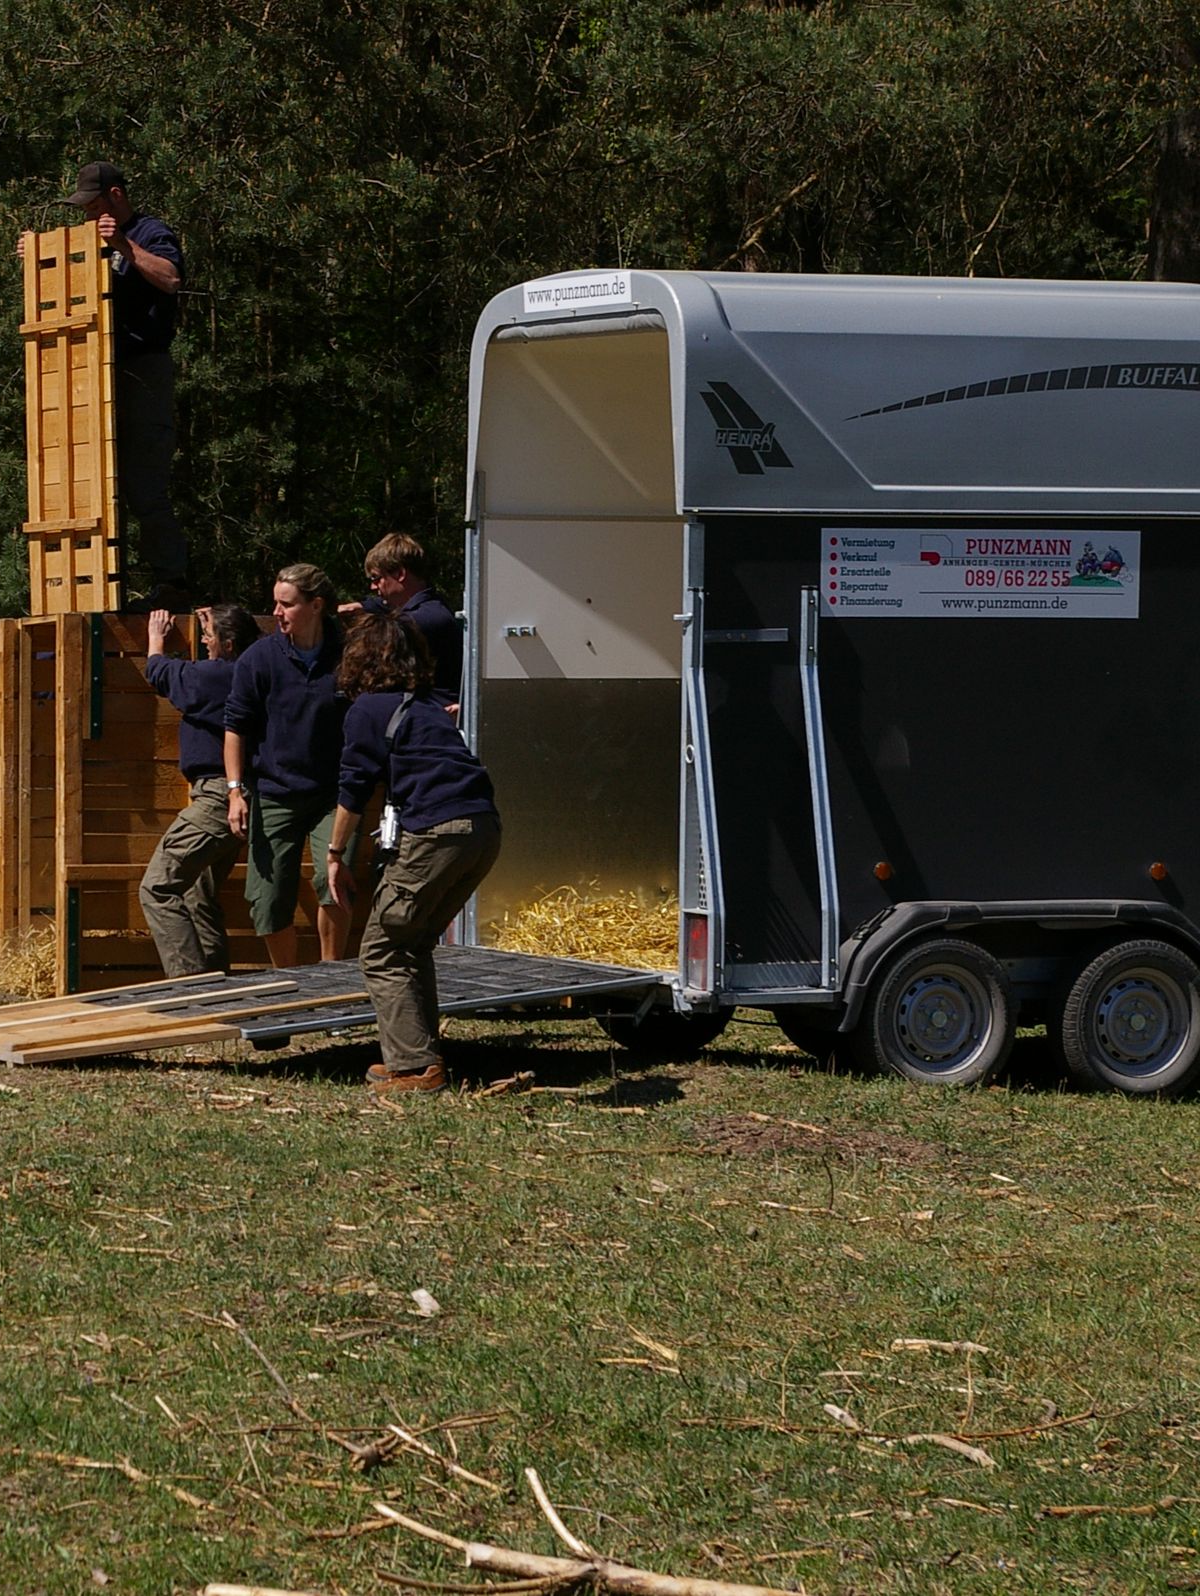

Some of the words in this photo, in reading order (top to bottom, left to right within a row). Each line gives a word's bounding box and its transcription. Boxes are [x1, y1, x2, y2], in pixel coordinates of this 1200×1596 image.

[527, 275, 626, 307] www.punzmann.de
[717, 431, 772, 447] HENRA
[841, 537, 896, 550] Vermietung
[966, 539, 1072, 556] PUNZMANN
[841, 552, 878, 562] Verkauf
[840, 567, 892, 577] Ersatzteile
[965, 569, 1024, 588] 089/66
[1027, 570, 1048, 587] 22
[1051, 570, 1071, 587] 55
[840, 582, 889, 593] Reparatur
[840, 596, 903, 608] Finanzierung
[941, 596, 1068, 612] www.punzmann.de
